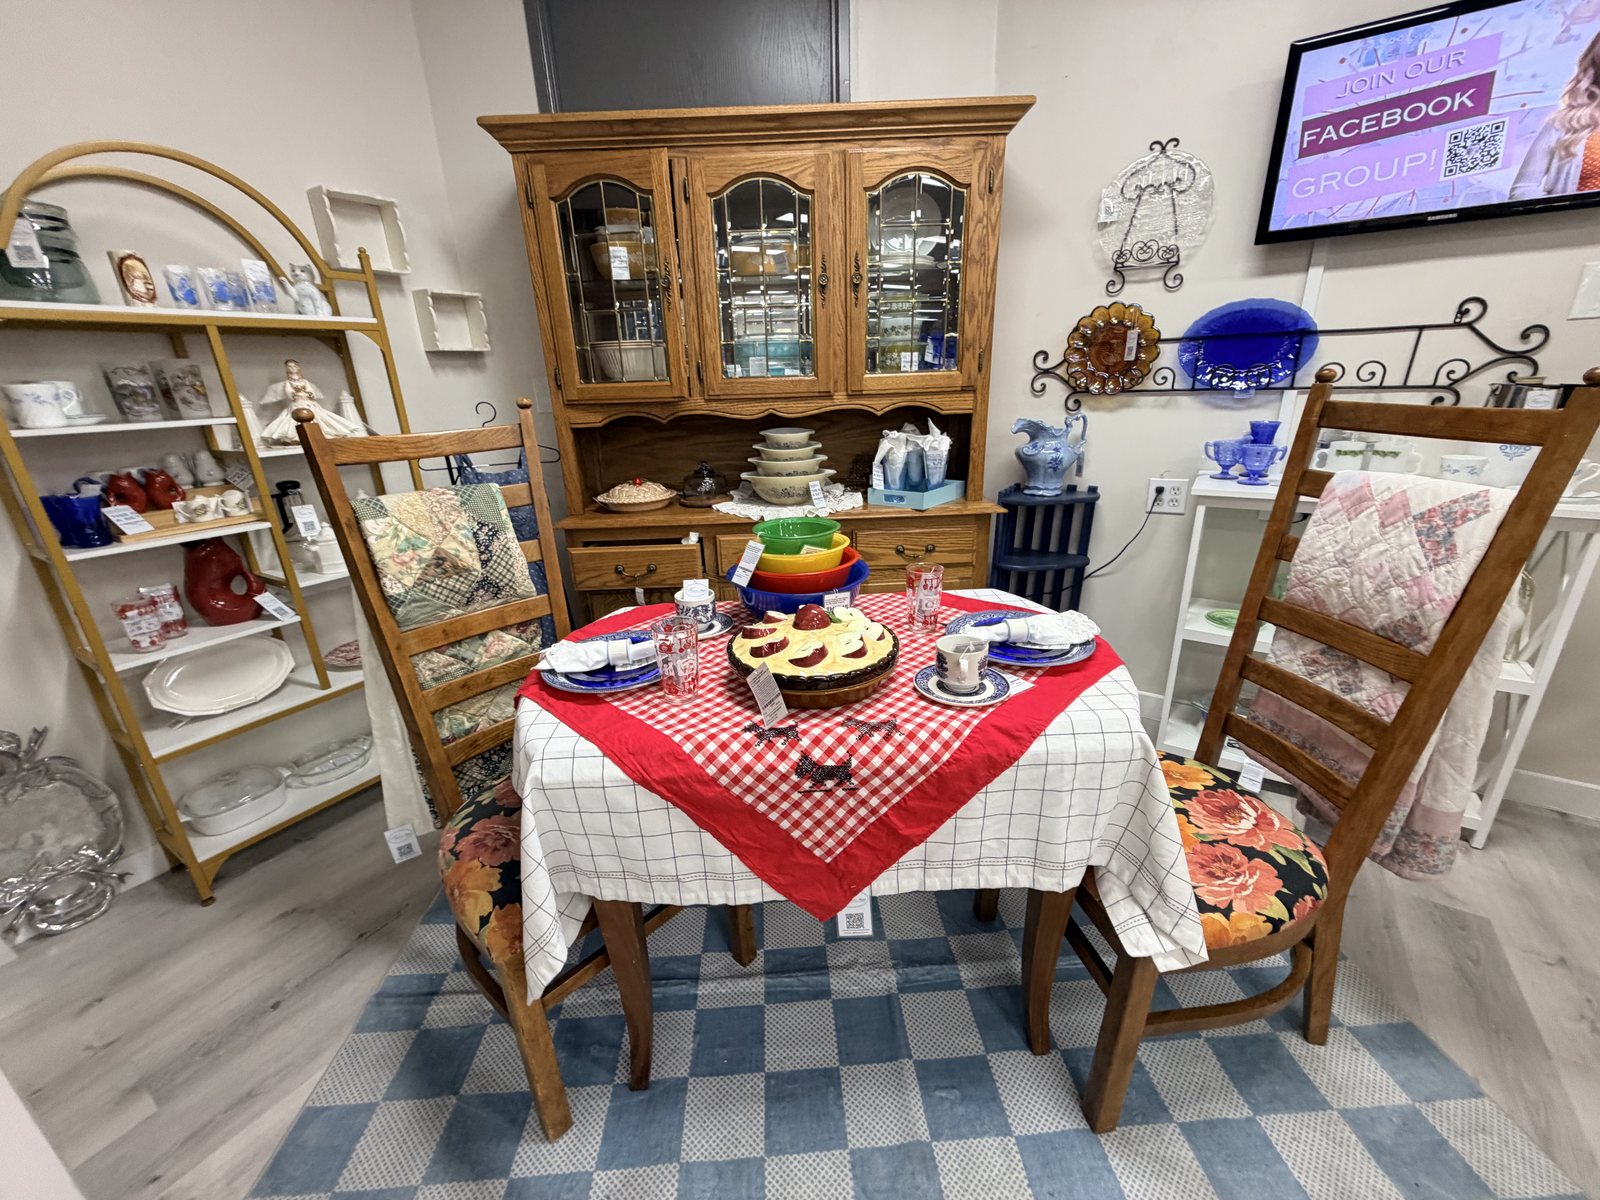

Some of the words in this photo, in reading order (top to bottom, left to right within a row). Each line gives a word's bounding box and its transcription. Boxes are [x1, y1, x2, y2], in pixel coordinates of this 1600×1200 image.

[1336, 69, 1396, 99] JOIN
[1404, 50, 1466, 80] OUR
[1302, 88, 1477, 149] FACEBOOK
[1292, 149, 1437, 199] GROUP!
